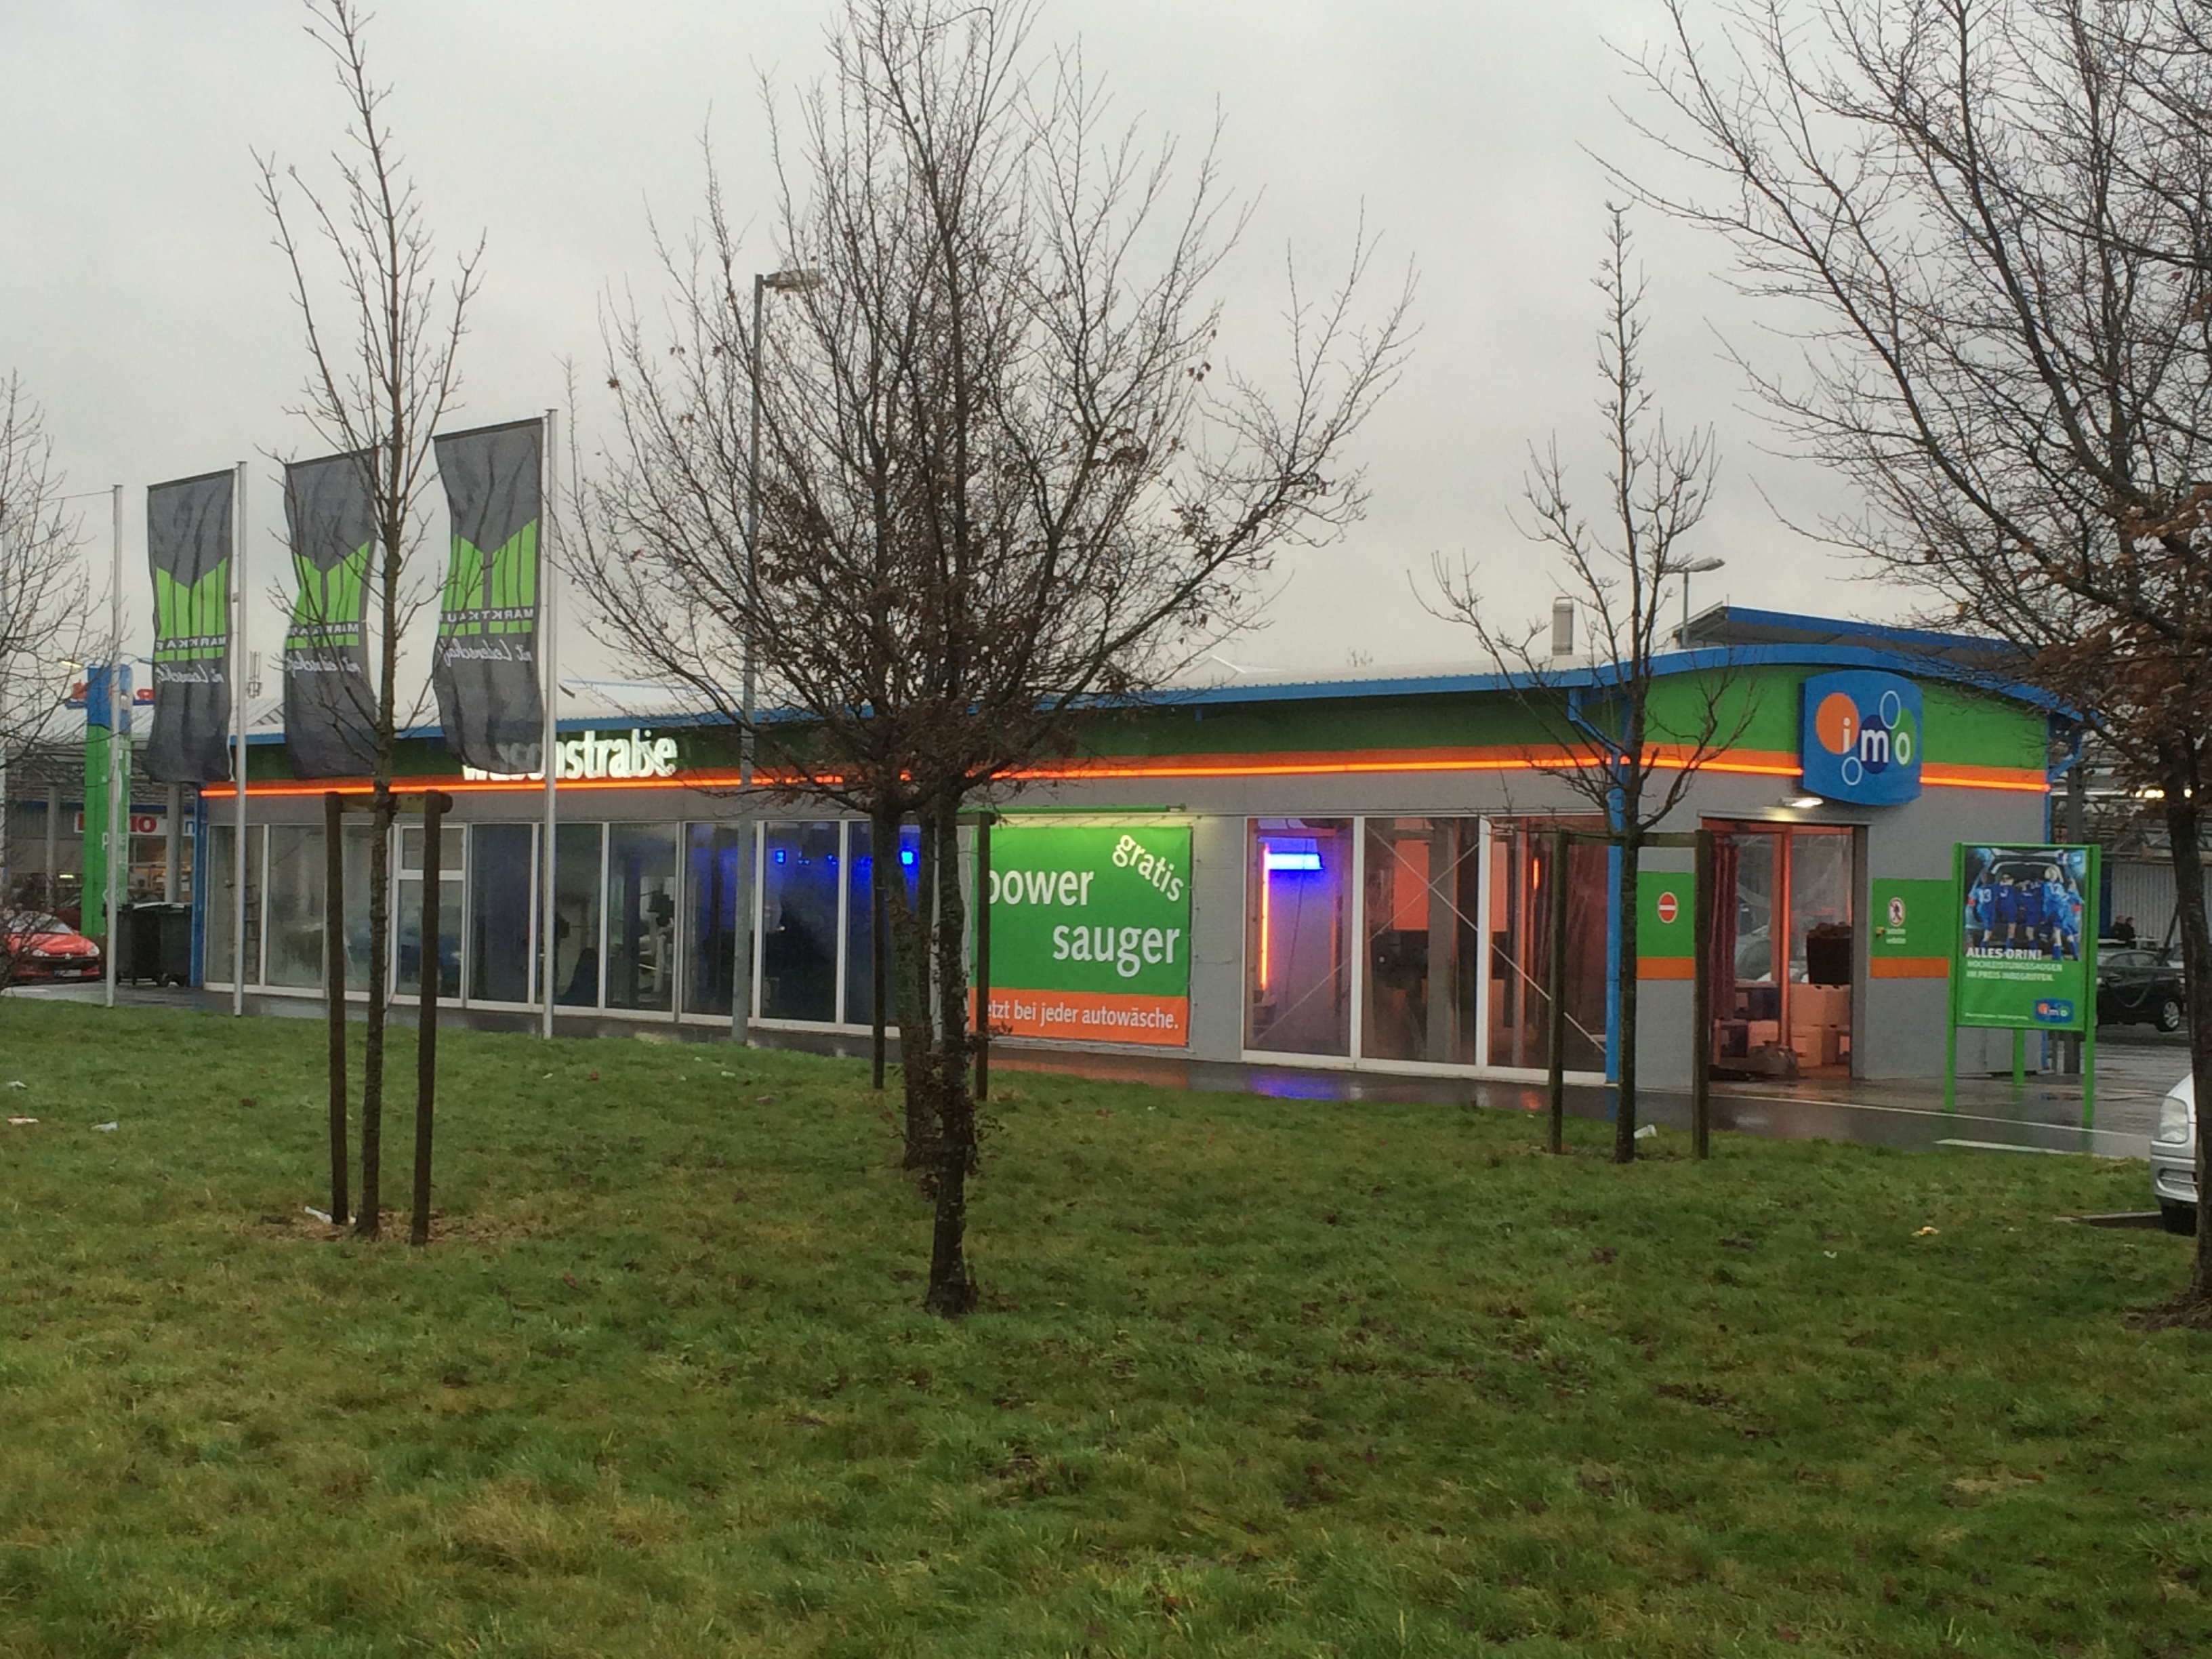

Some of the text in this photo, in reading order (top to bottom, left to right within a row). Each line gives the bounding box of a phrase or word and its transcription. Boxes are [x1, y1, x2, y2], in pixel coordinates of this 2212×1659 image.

[1843, 717, 1910, 765] imo
[1112, 834, 1184, 902] gratis
[1052, 925, 1181, 977] sauger
[1966, 947, 2003, 958] ALLES
[988, 1000, 1179, 1029] tzt bei jeder autowäsche.
